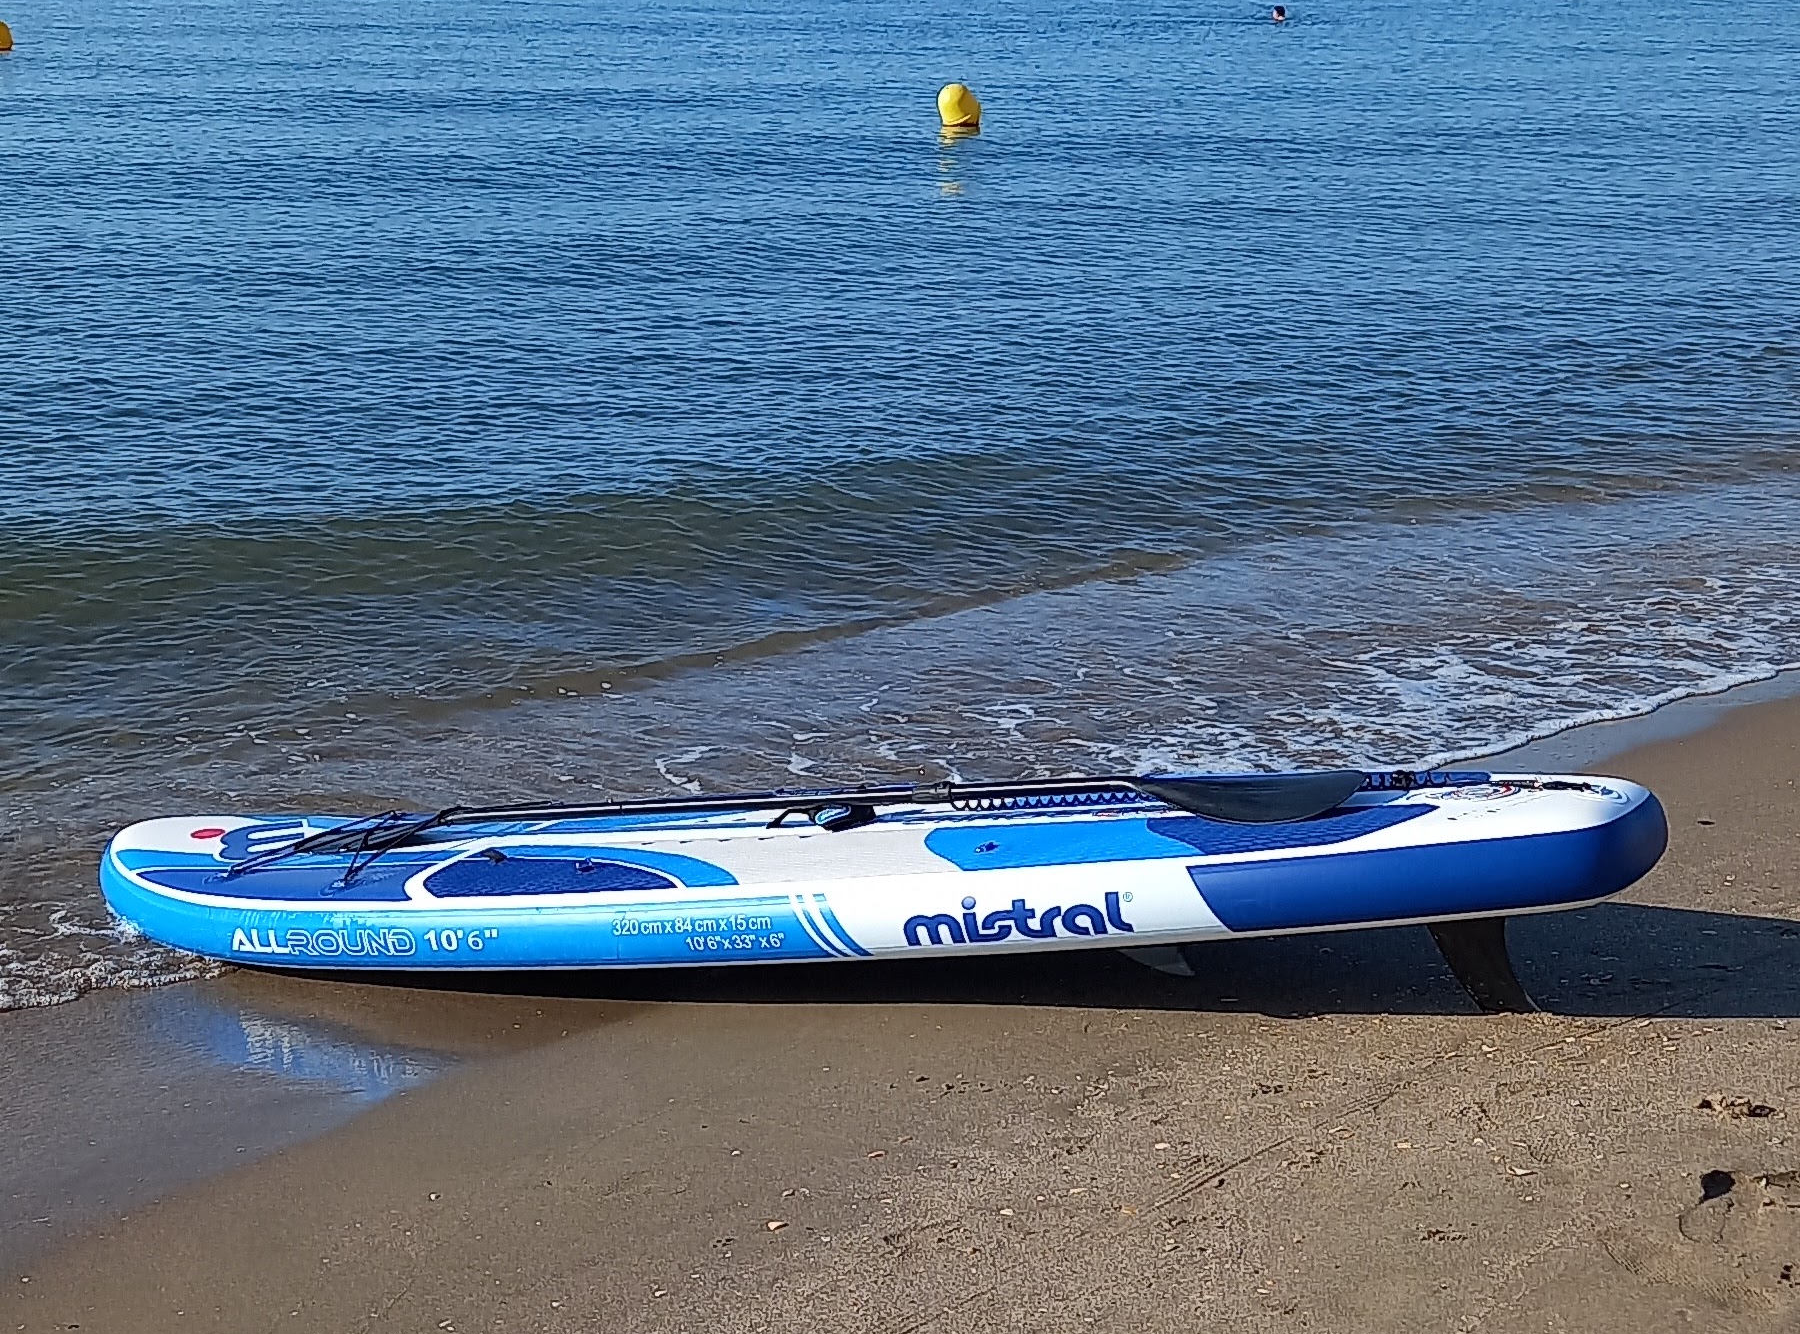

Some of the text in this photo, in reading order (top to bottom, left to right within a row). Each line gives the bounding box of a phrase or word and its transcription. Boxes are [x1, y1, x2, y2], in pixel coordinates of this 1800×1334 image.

[612, 914, 772, 935] 320 cm x 84 cm x 15 cm
[903, 891, 1134, 946] mistral
[758, 936, 770, 948] x
